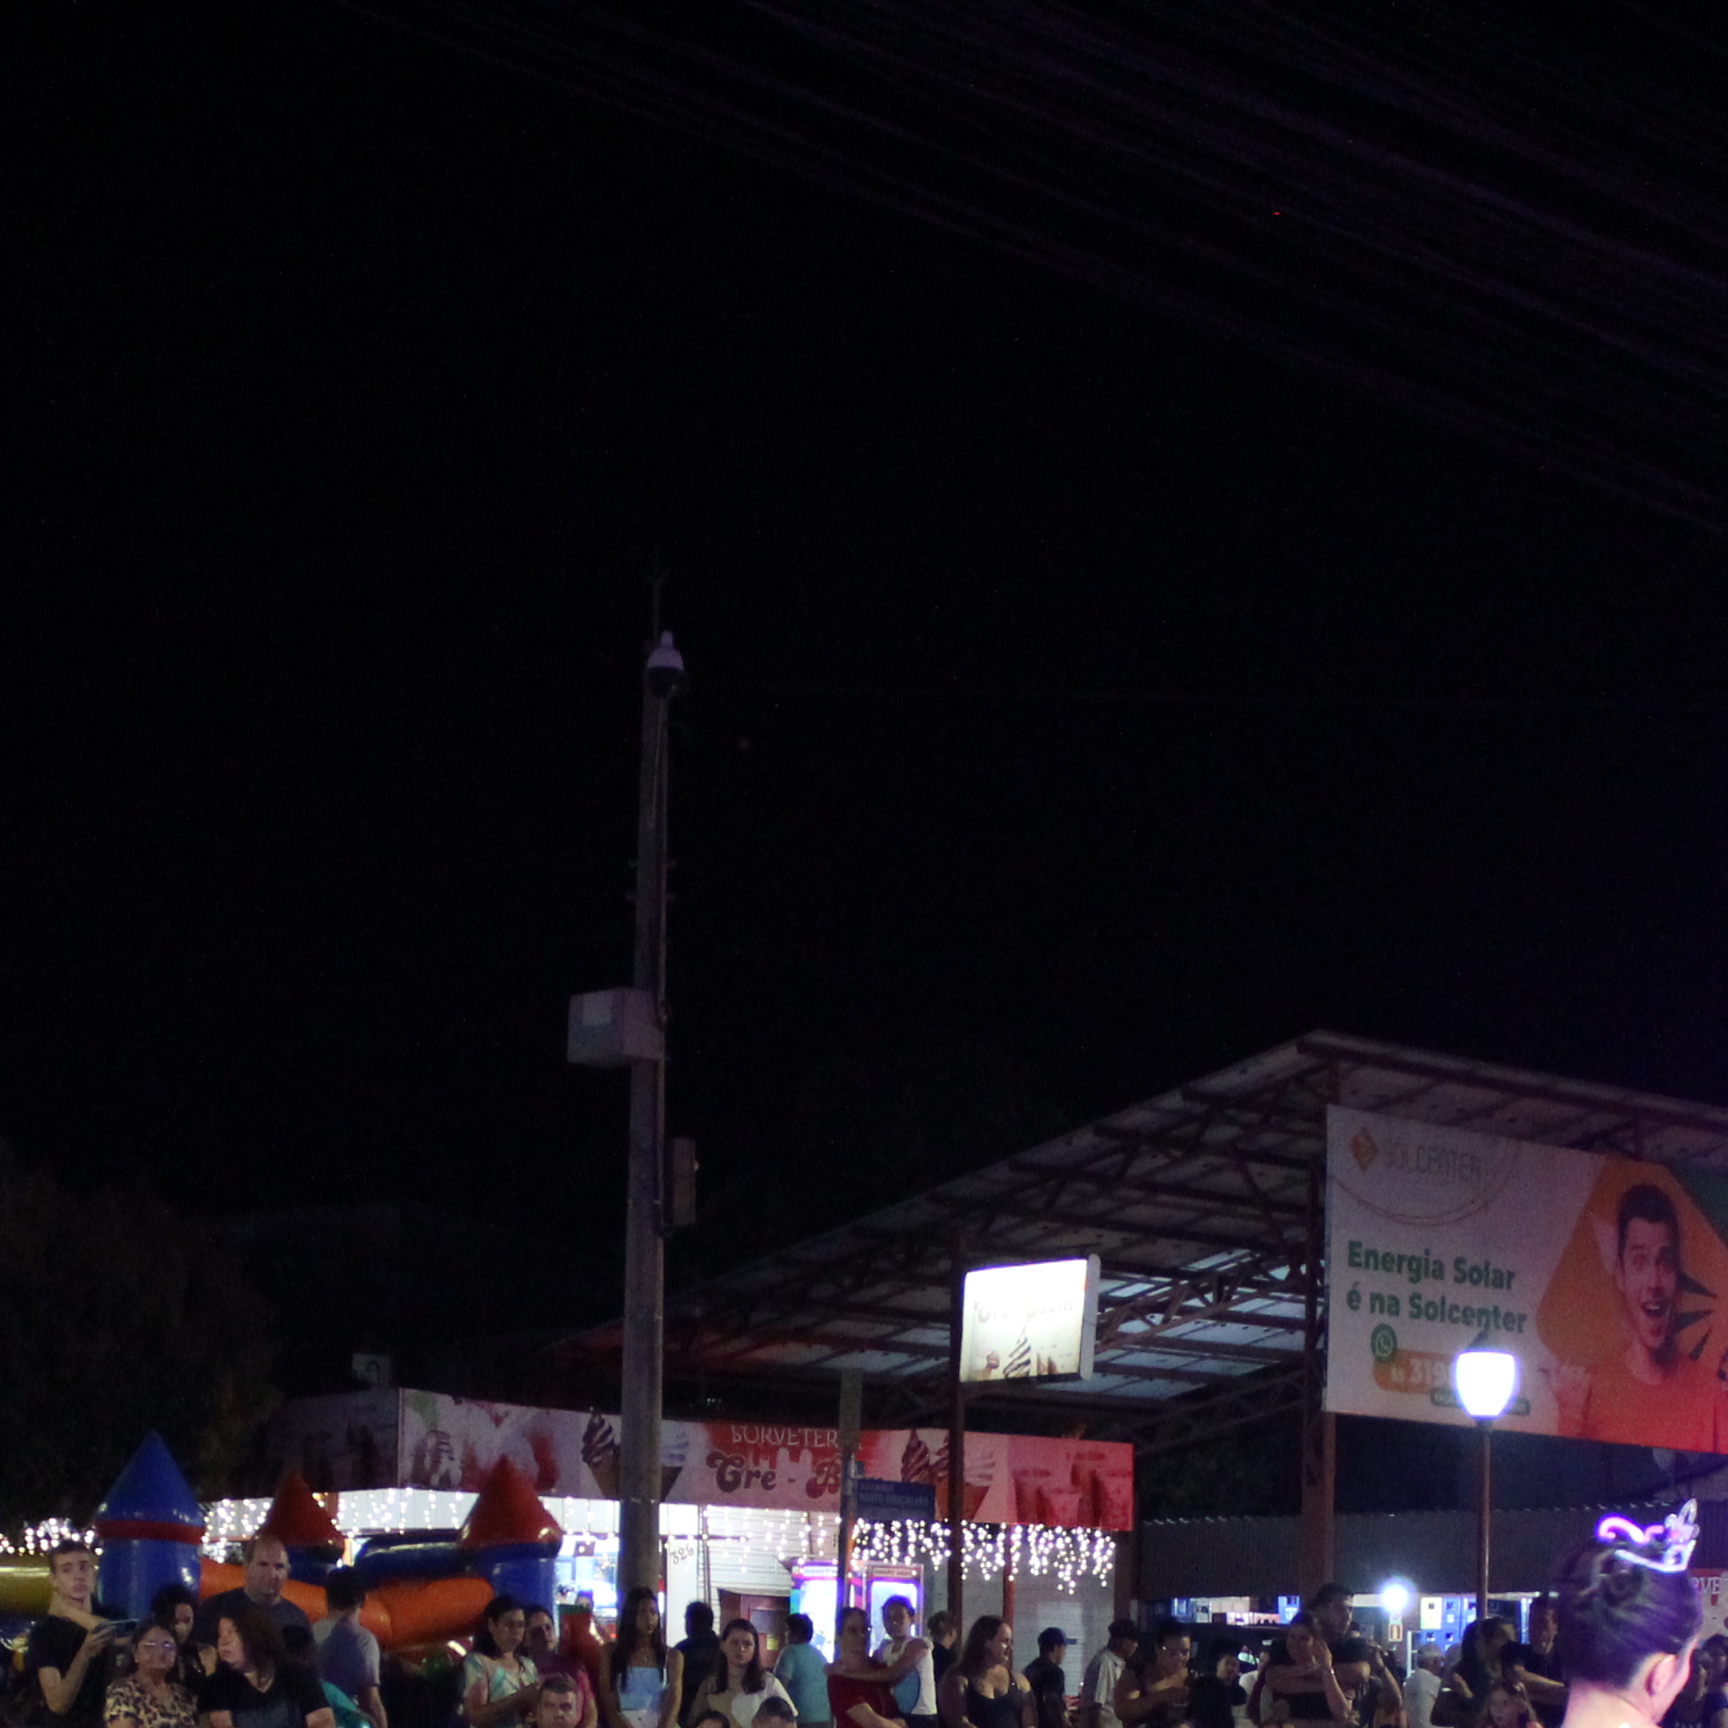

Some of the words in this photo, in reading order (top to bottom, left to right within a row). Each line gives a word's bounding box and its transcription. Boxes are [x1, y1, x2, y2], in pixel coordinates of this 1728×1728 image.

[1347, 1241, 1445, 1284] Energia
[1453, 1257, 1515, 1291] Solar
[1346, 1282, 1362, 1311] é
[1370, 1292, 1401, 1317] na
[1408, 1292, 1528, 1333] Solcenter
[731, 1423, 840, 1448] SORVETER
